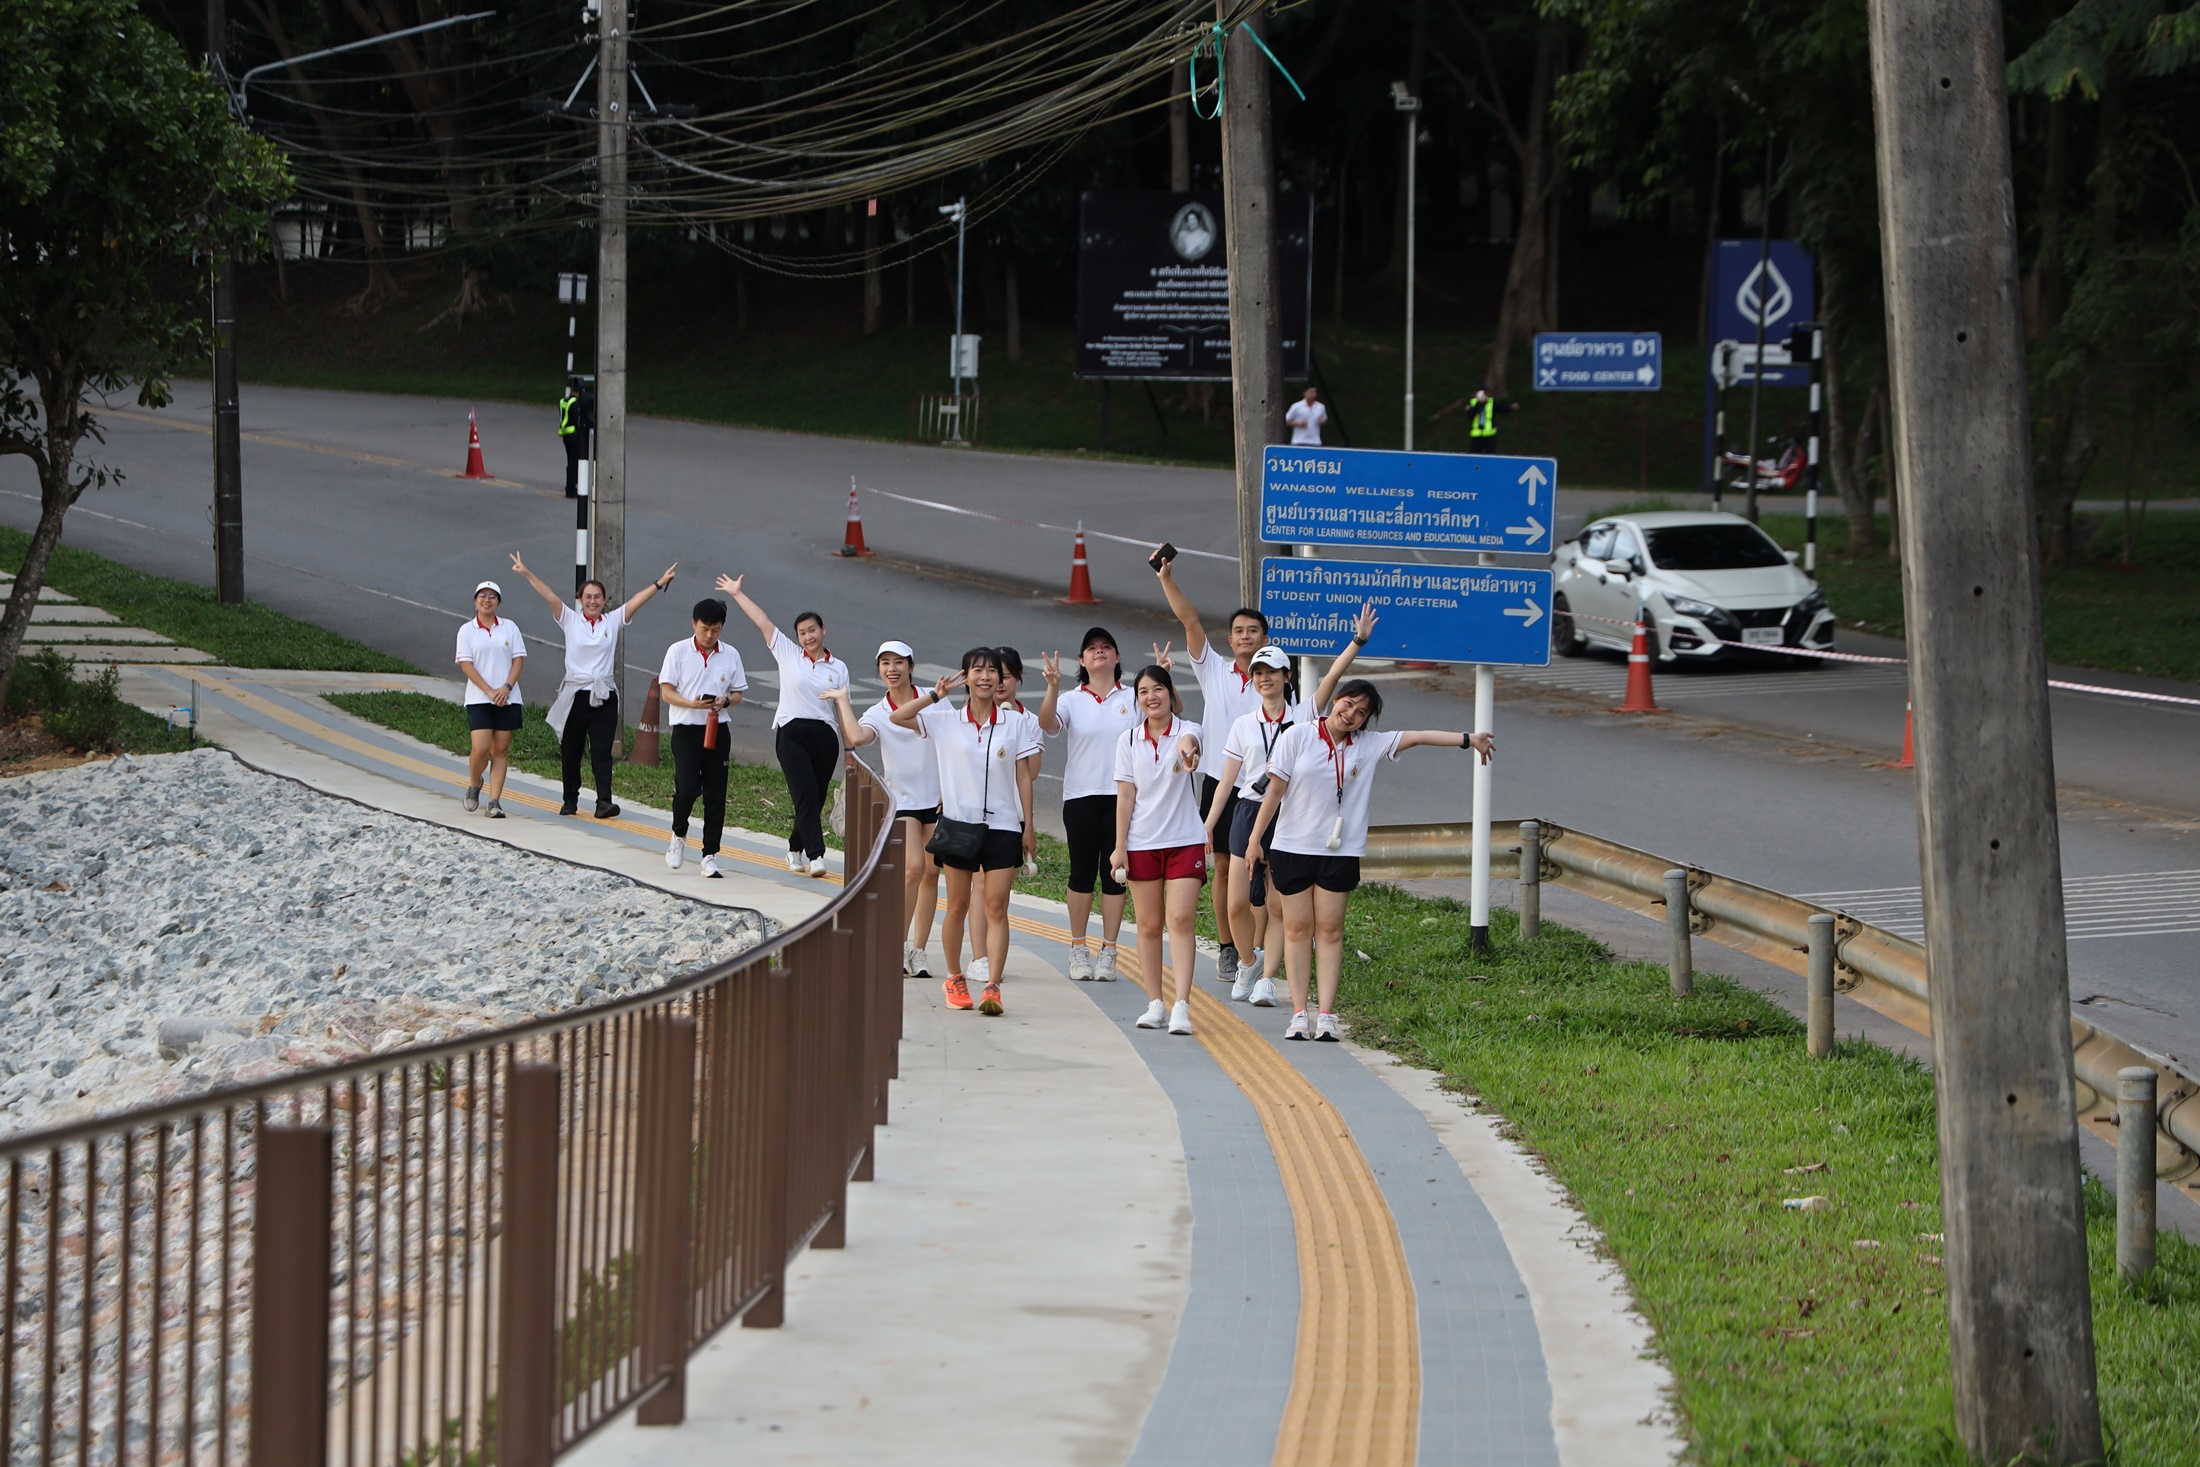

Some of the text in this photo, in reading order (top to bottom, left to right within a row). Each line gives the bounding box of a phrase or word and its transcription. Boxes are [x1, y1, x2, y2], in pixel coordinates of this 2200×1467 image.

[1540, 337, 1656, 364] ศูนย์อาหาร D1
[1560, 371, 1635, 382] FOOD CENTER
[1267, 458, 1341, 475] วนาศรม
[1270, 483, 1478, 501] WANASOM WELLNESS RESORT
[1266, 501, 1480, 528] ศูนย์บรรณสารและสื่อการศึกษา
[1266, 525, 1504, 545] CENTER FOR LEARNING RESOURCES AND EDUCATIONAL MEDIA
[1266, 566, 1536, 596] อาคารกิจกรรมนักศึกษาและศูนย์อาหาร
[1266, 590, 1458, 609] STUDENT UNION AND CAFETERIA
